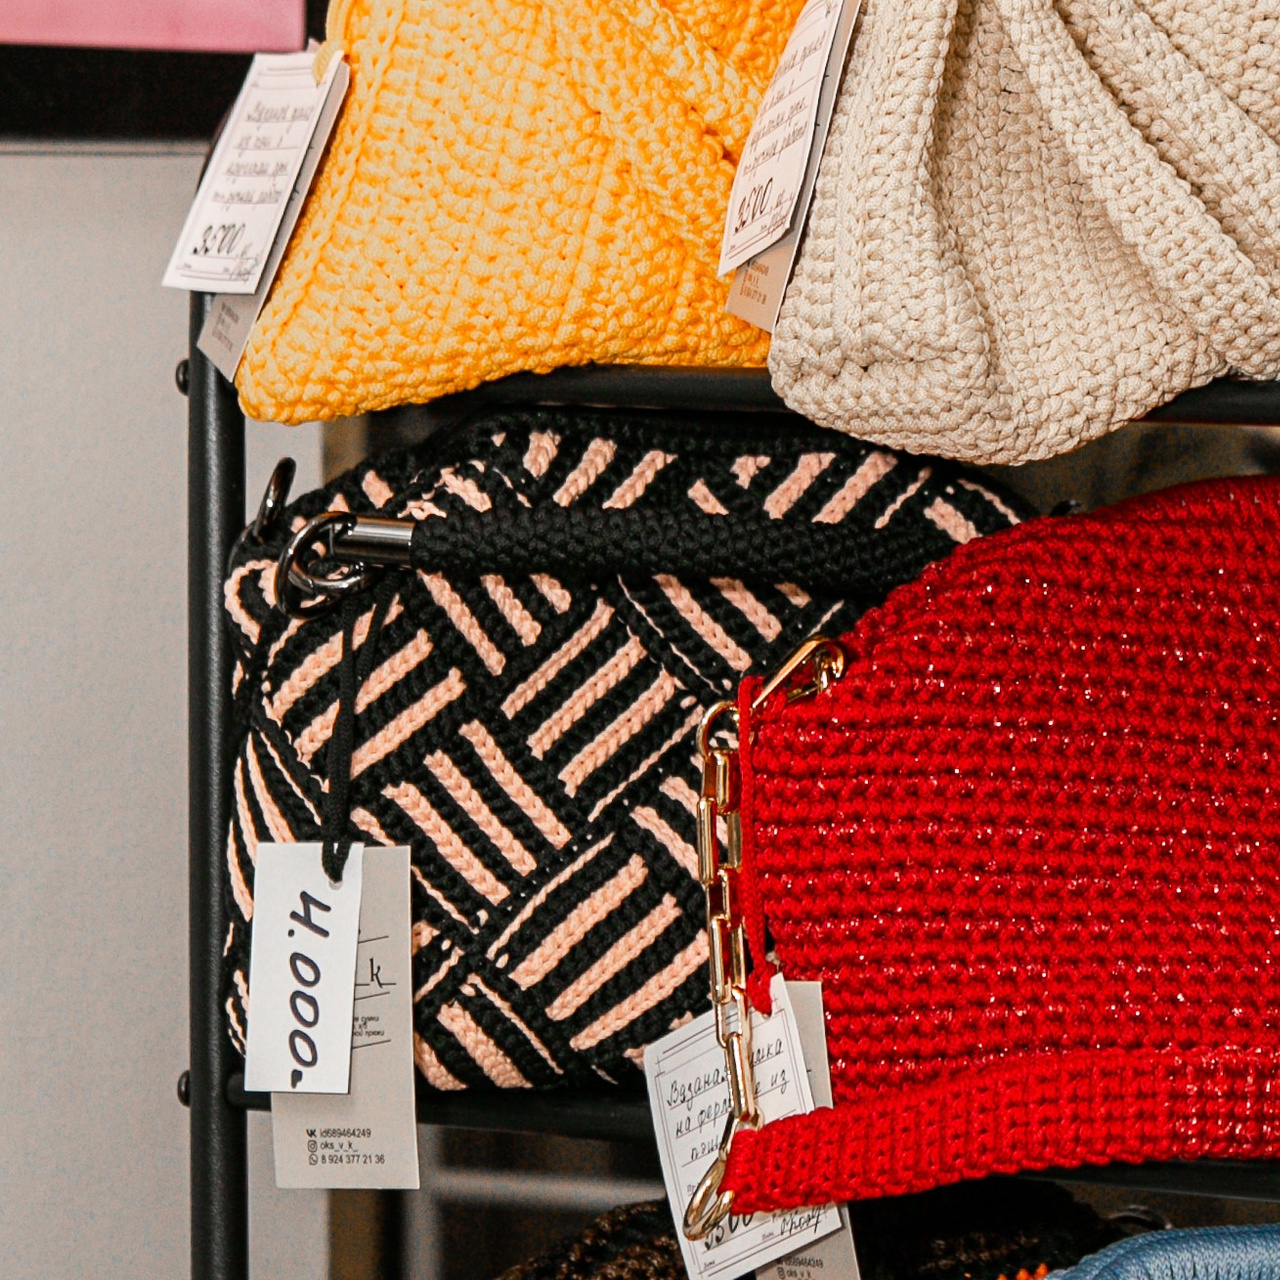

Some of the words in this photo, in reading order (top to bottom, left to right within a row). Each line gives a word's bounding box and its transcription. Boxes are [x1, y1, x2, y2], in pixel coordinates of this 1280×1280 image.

[676, 1116, 691, 1136] на
[771, 1069, 786, 1094] из
[328, 1154, 343, 1164] 924
[345, 1154, 360, 1164] 377
[363, 1154, 372, 1164] 21
[375, 1154, 385, 1164] 36
